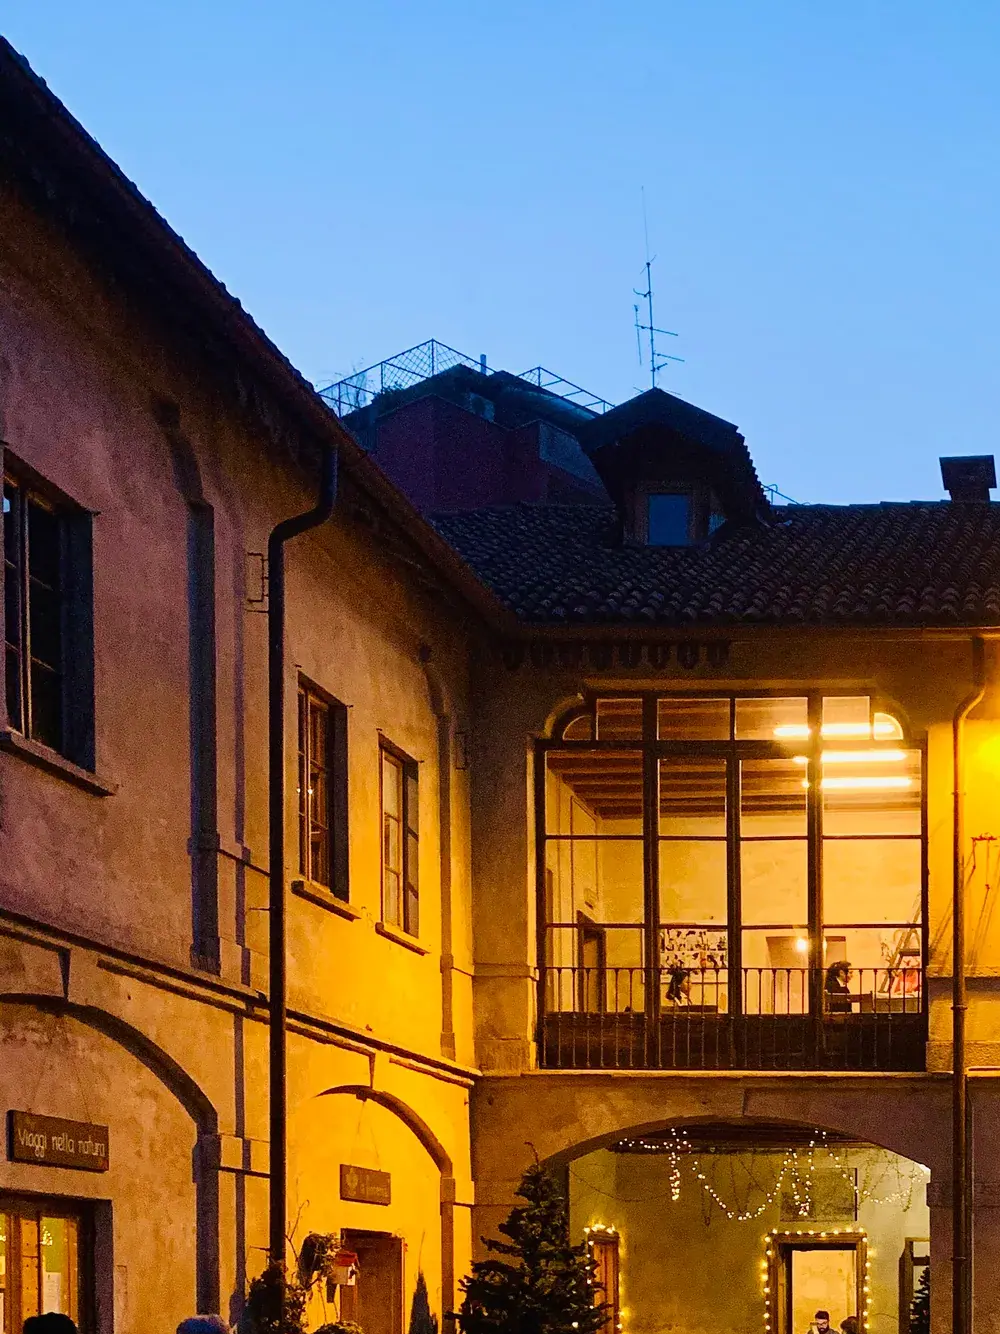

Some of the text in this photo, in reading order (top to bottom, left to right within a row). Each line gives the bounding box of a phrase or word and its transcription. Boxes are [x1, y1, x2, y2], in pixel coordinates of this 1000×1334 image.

[17, 1127, 106, 1158] Viaggi nella natura
